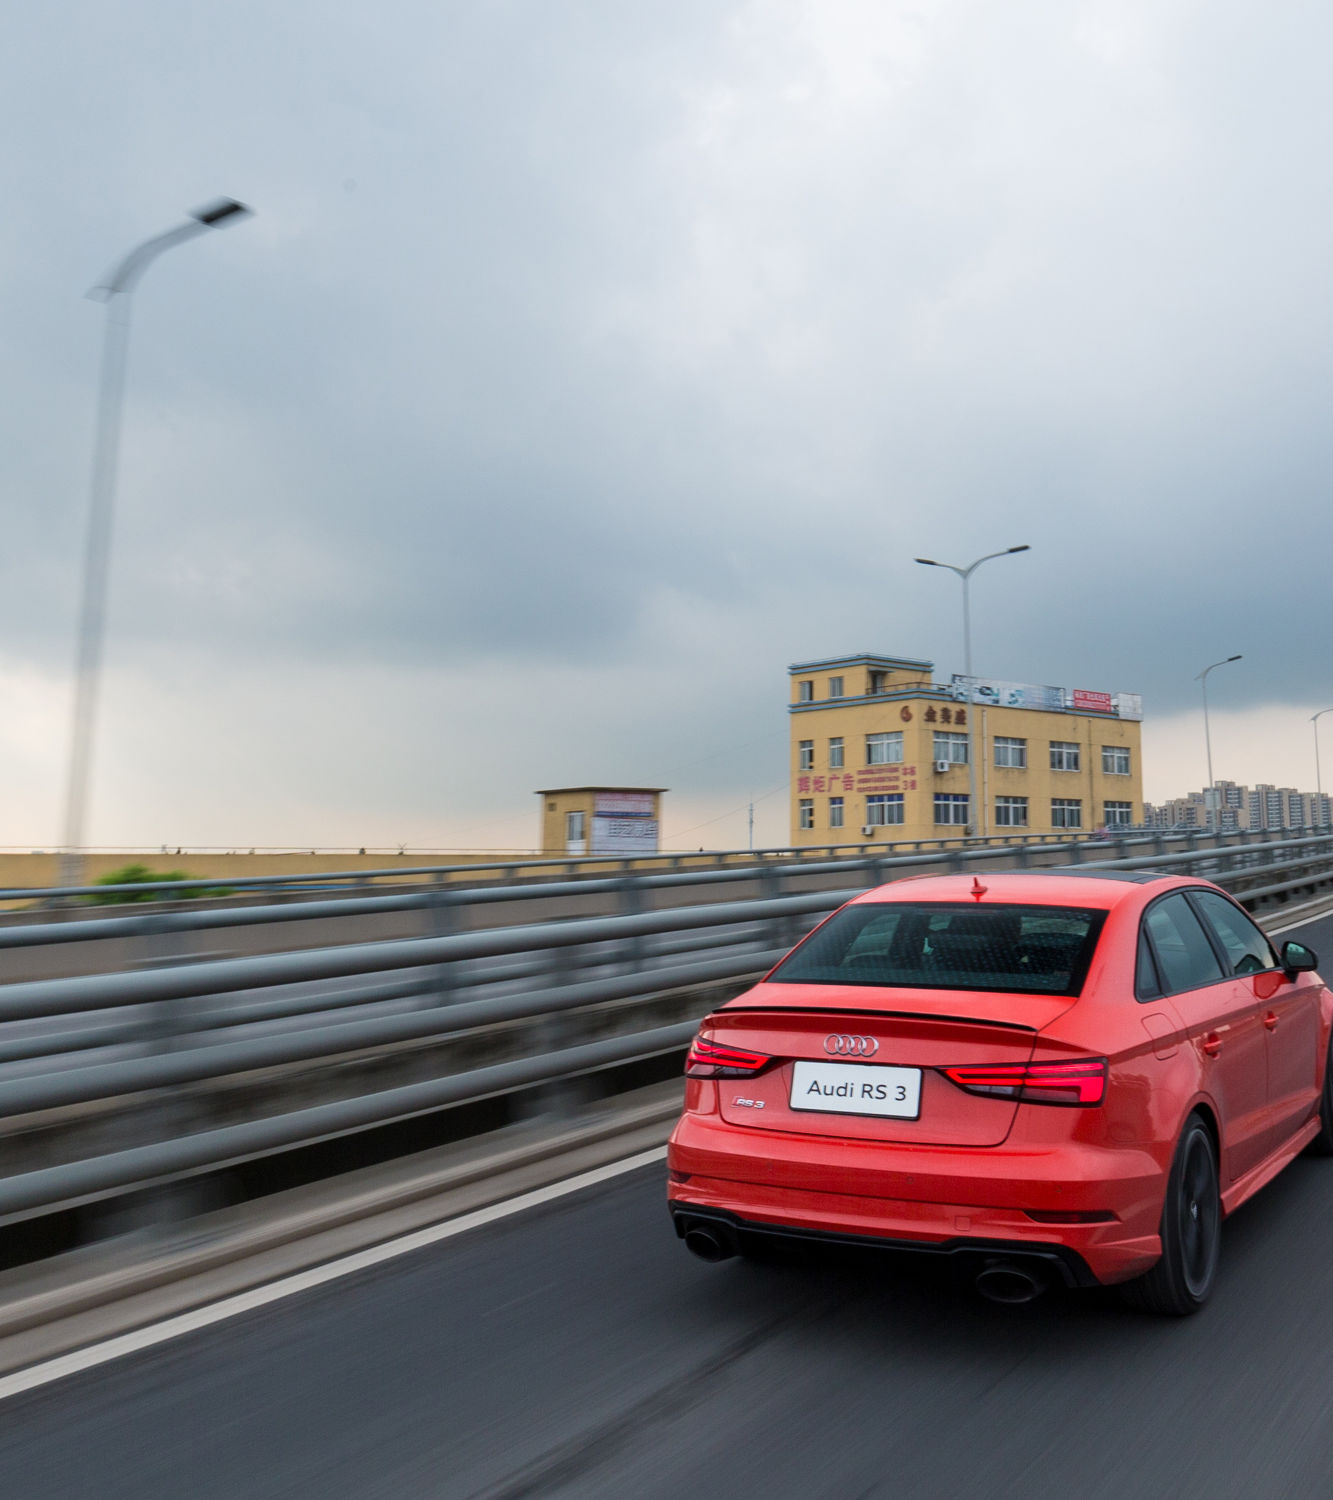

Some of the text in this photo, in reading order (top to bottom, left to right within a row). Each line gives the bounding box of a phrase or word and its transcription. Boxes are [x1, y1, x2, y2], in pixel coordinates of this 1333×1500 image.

[807, 1080, 907, 1101] Audi RS 3
[736, 1098, 766, 1109] RS 3
